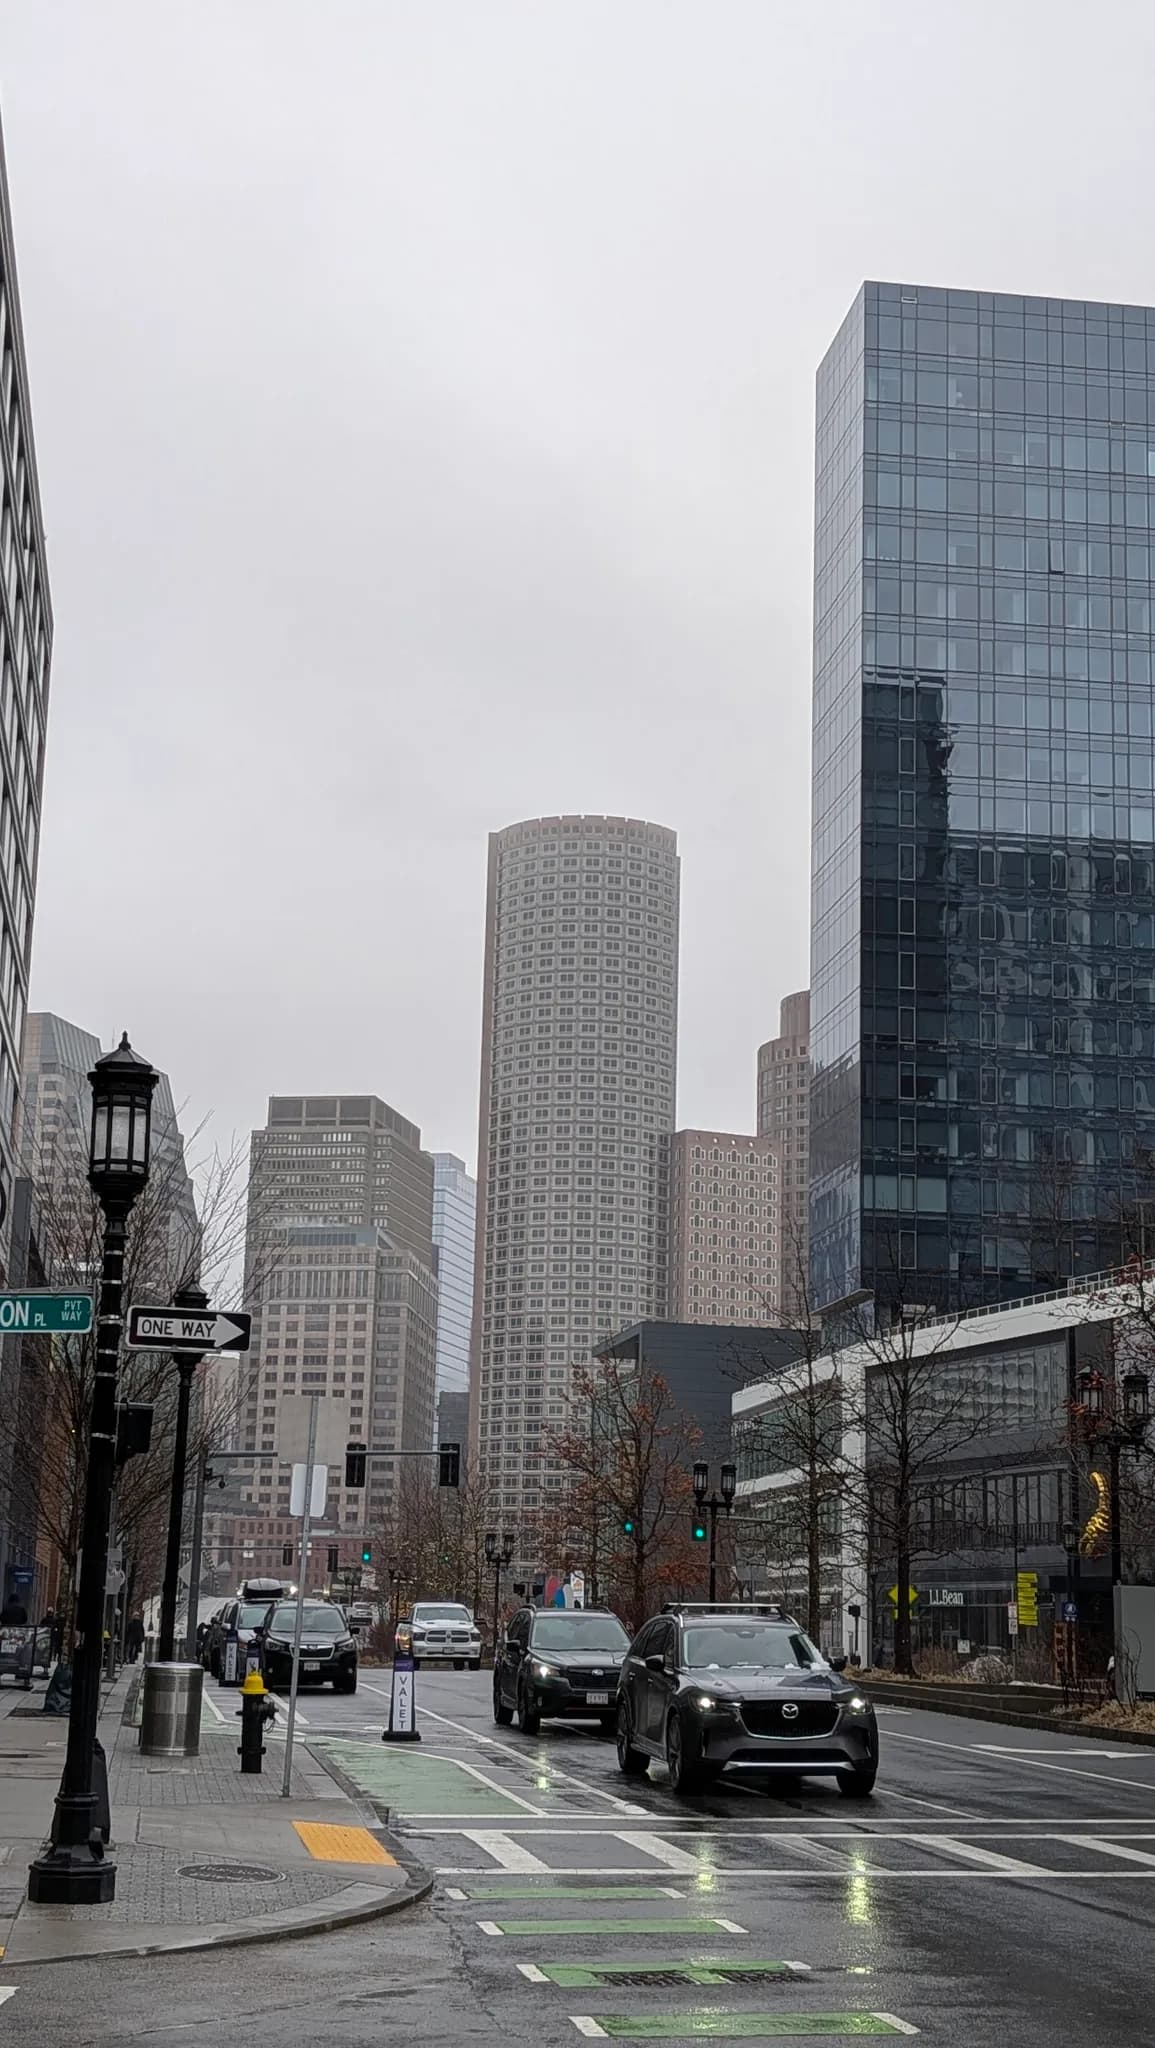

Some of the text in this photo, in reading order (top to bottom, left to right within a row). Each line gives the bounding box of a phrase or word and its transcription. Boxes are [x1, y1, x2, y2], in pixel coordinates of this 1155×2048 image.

[0, 1301, 47, 1327] ON PL
[64, 1300, 82, 1311] PVT
[61, 1311, 82, 1321] WAY
[141, 1319, 216, 1338] ONE WAY
[399, 1676, 408, 1729] VALET
